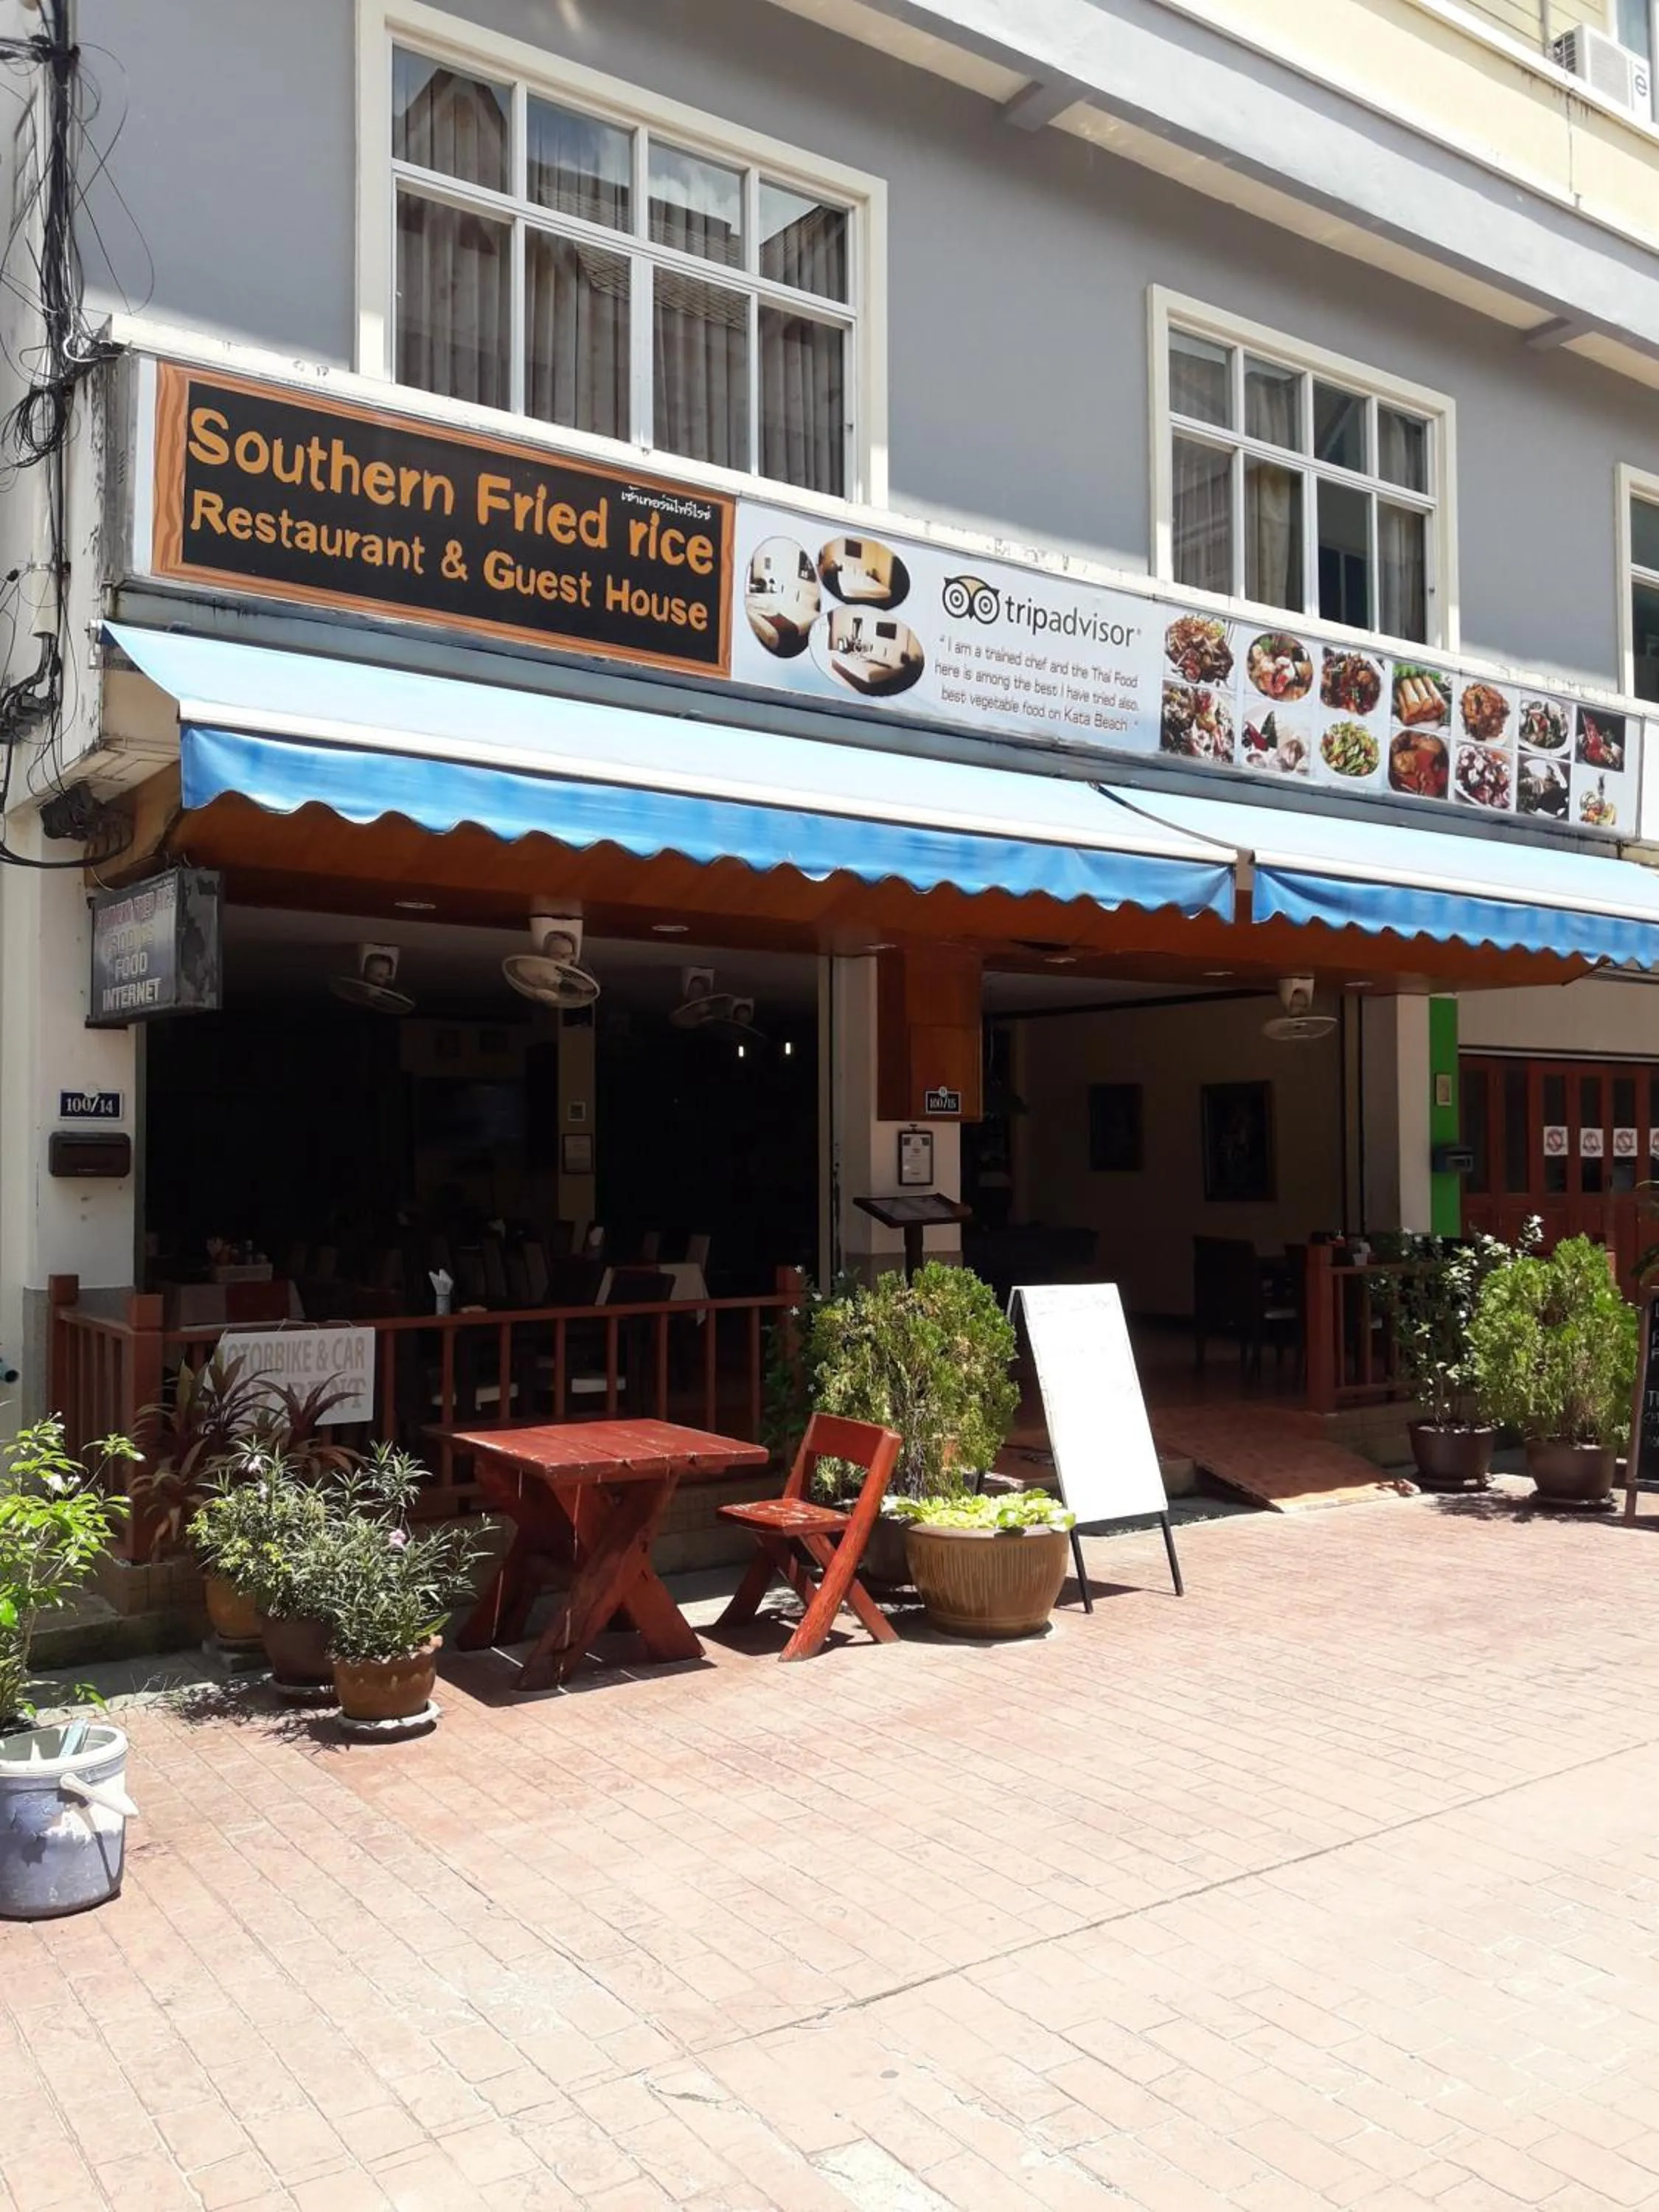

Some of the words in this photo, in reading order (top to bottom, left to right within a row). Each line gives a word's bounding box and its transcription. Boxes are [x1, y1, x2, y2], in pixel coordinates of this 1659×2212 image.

[188, 408, 454, 515] Southern
[476, 473, 608, 549] Fried
[629, 512, 714, 575] rice
[191, 490, 425, 576] Restaurant
[442, 542, 468, 580] &
[483, 550, 591, 607] Guest
[605, 574, 708, 631] House
[1005, 597, 1134, 647] tripadvisor
[934, 658, 960, 678] here
[963, 663, 973, 681] is
[975, 670, 1011, 691] among
[1014, 675, 1032, 692] the
[1034, 678, 1057, 697] best
[1066, 684, 1090, 703] have
[1092, 690, 1116, 707] tried
[955, 641, 971, 655] am
[973, 646, 981, 658] a
[985, 646, 1023, 667] trained
[1024, 652, 1048, 671] chef
[1050, 660, 1069, 676] and
[1071, 664, 1089, 679] the
[1091, 665, 1112, 684] Thai
[1114, 670, 1138, 689] Food
[941, 684, 967, 704] best
[970, 692, 1020, 713] vegetable
[1023, 700, 1046, 717] food
[1048, 708, 1061, 721] on
[1064, 705, 1091, 726] Kata
[1094, 709, 1128, 732] Beach
[115, 952, 148, 981] FOOD
[102, 977, 162, 1012] INTERNET
[66, 1095, 114, 1113] 100/14
[219, 1340, 313, 1375] OTORBIKE
[316, 1338, 329, 1371] &
[331, 1336, 366, 1370] CAR
